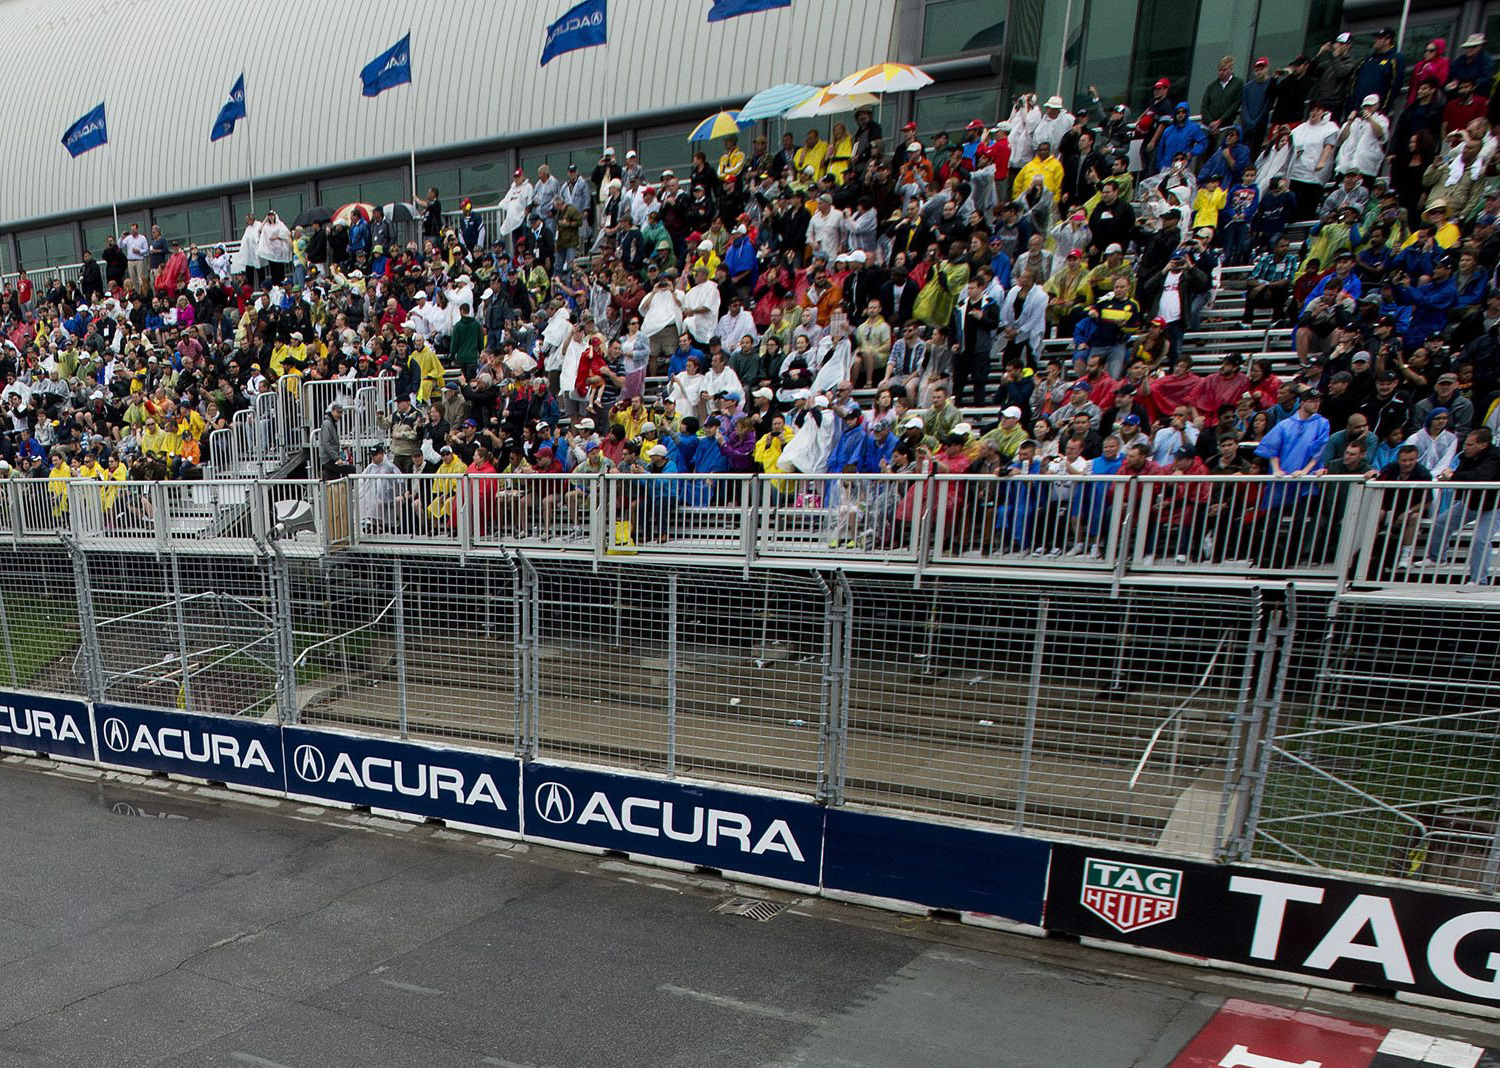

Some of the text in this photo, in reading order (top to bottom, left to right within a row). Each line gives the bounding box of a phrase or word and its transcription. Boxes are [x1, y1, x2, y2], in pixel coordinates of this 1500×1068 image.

[131, 725, 275, 774] ACURA
[328, 753, 507, 811] ACURA
[576, 791, 805, 860] ACURA
[1093, 863, 1172, 896] TAG
[1085, 887, 1173, 929] HEUER
[1228, 875, 1500, 1000] TAG
